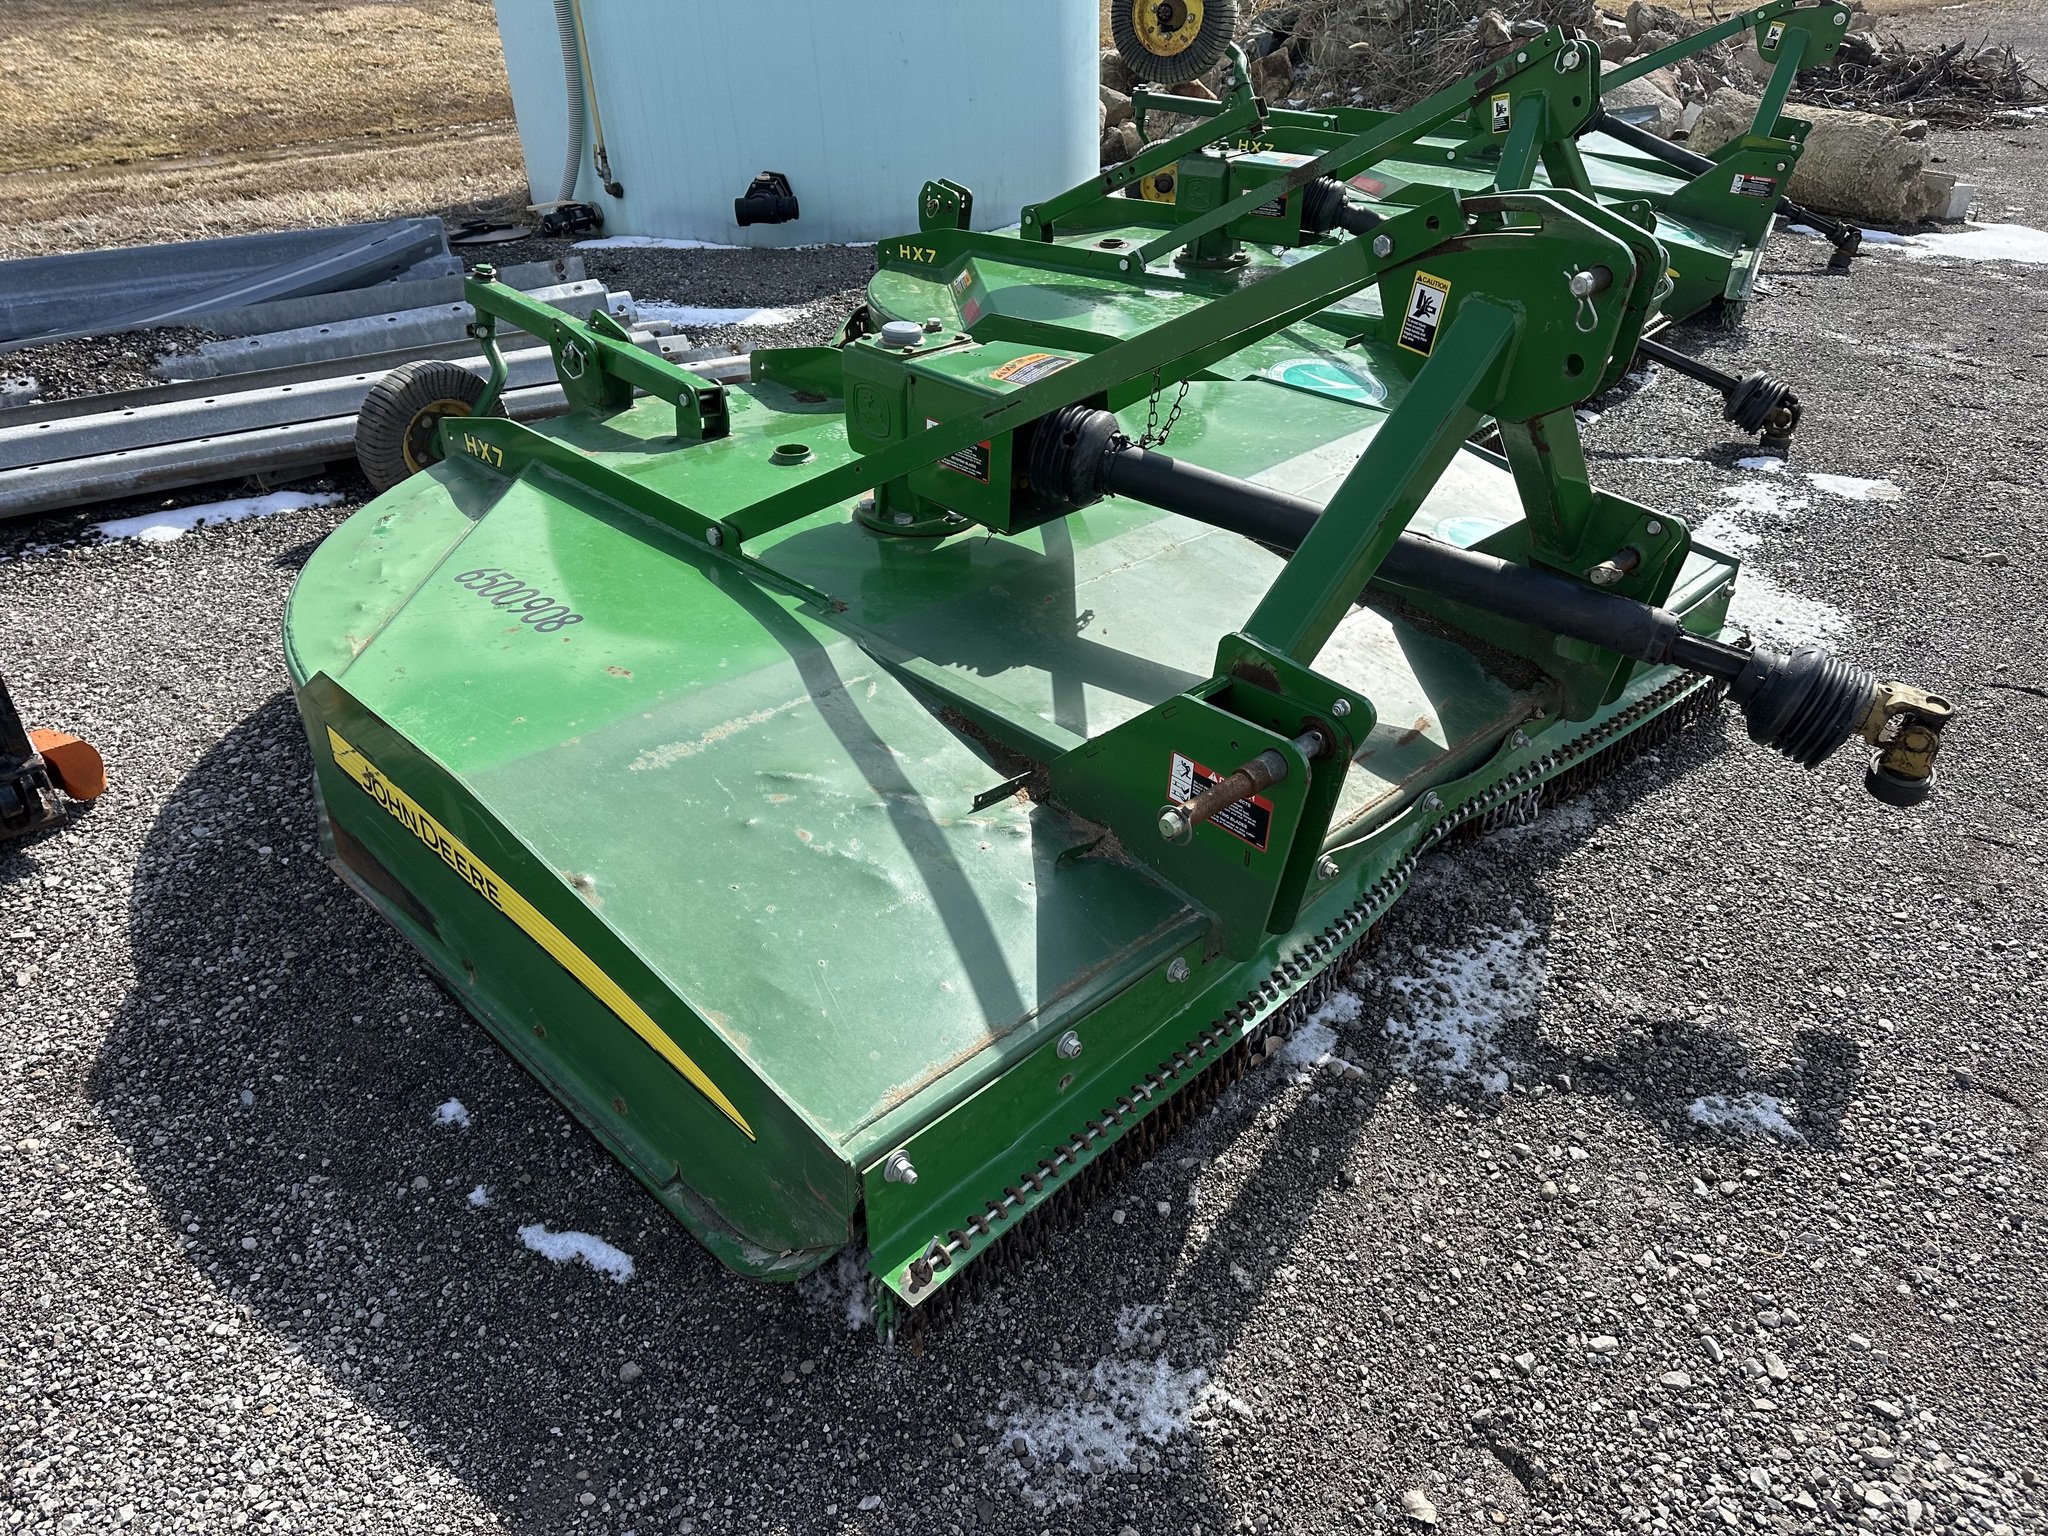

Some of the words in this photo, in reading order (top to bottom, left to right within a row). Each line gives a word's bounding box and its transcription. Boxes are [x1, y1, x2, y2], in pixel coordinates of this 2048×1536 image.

[898, 243, 937, 264] HX7
[1422, 276, 1449, 290] CAUTION
[463, 432, 503, 469] HX7
[454, 567, 584, 633] 6500908
[361, 766, 419, 837] JOHN
[418, 813, 502, 909] DEERE
